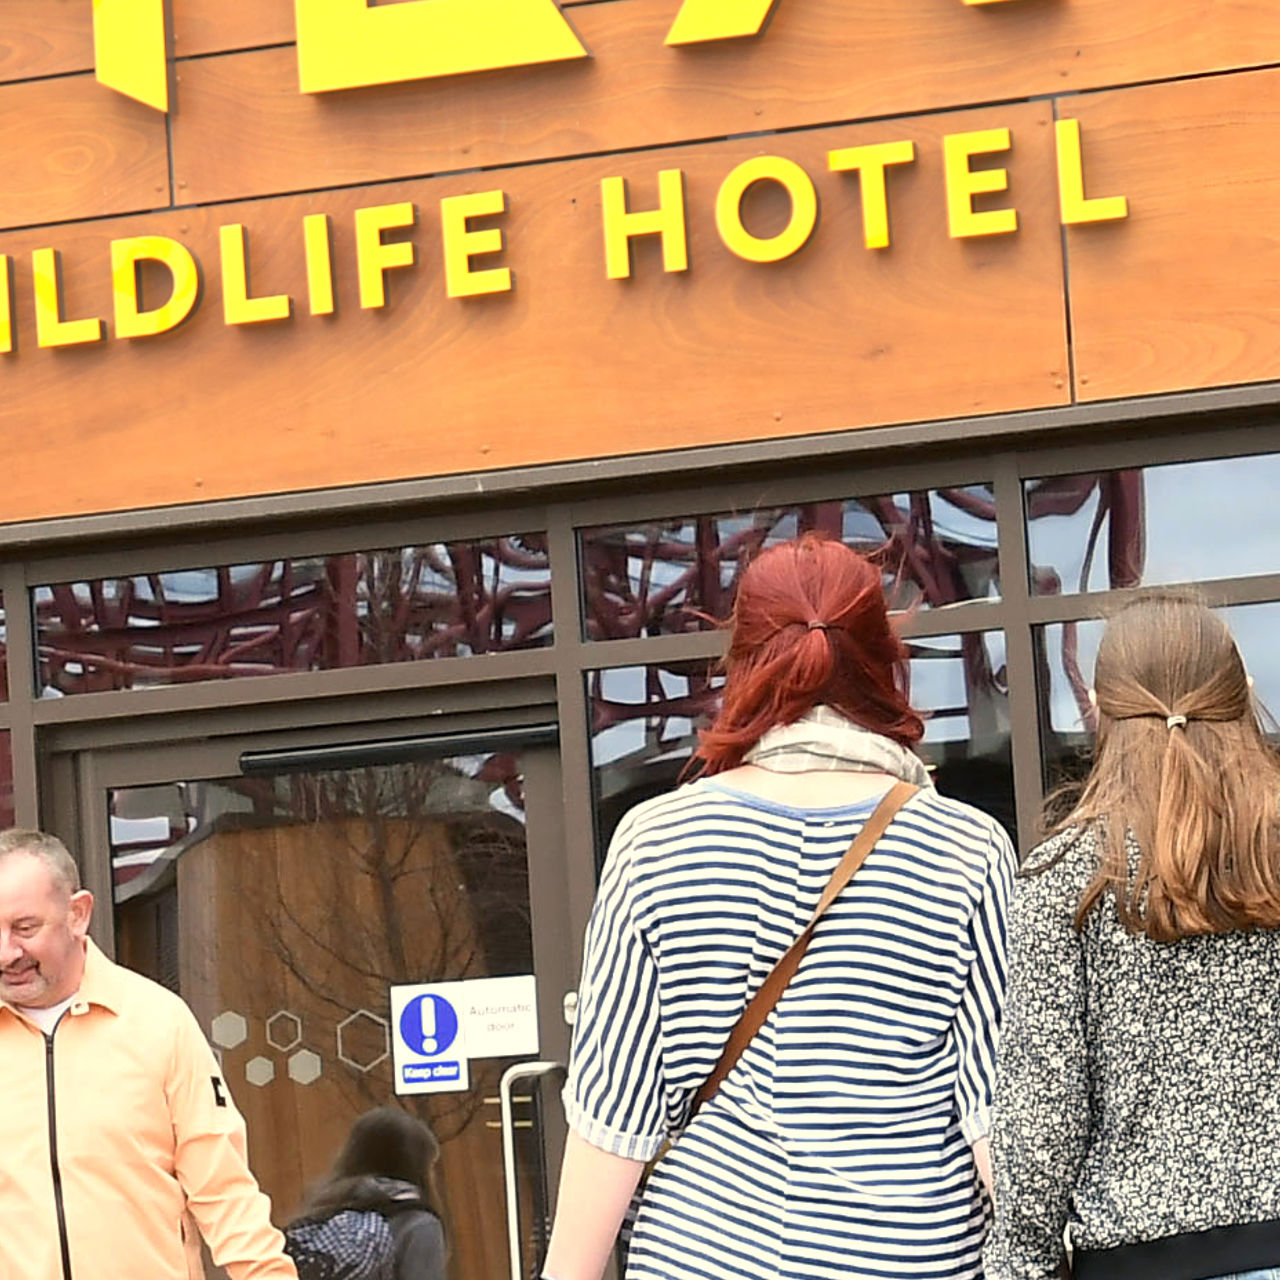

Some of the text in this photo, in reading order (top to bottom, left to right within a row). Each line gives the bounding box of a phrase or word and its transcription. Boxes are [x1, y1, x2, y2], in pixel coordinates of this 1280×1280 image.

[600, 118, 1129, 280] HOTEL
[469, 1004, 532, 1016] Automatic
[487, 1022, 515, 1032] door
[404, 1065, 458, 1080] Keep clear
